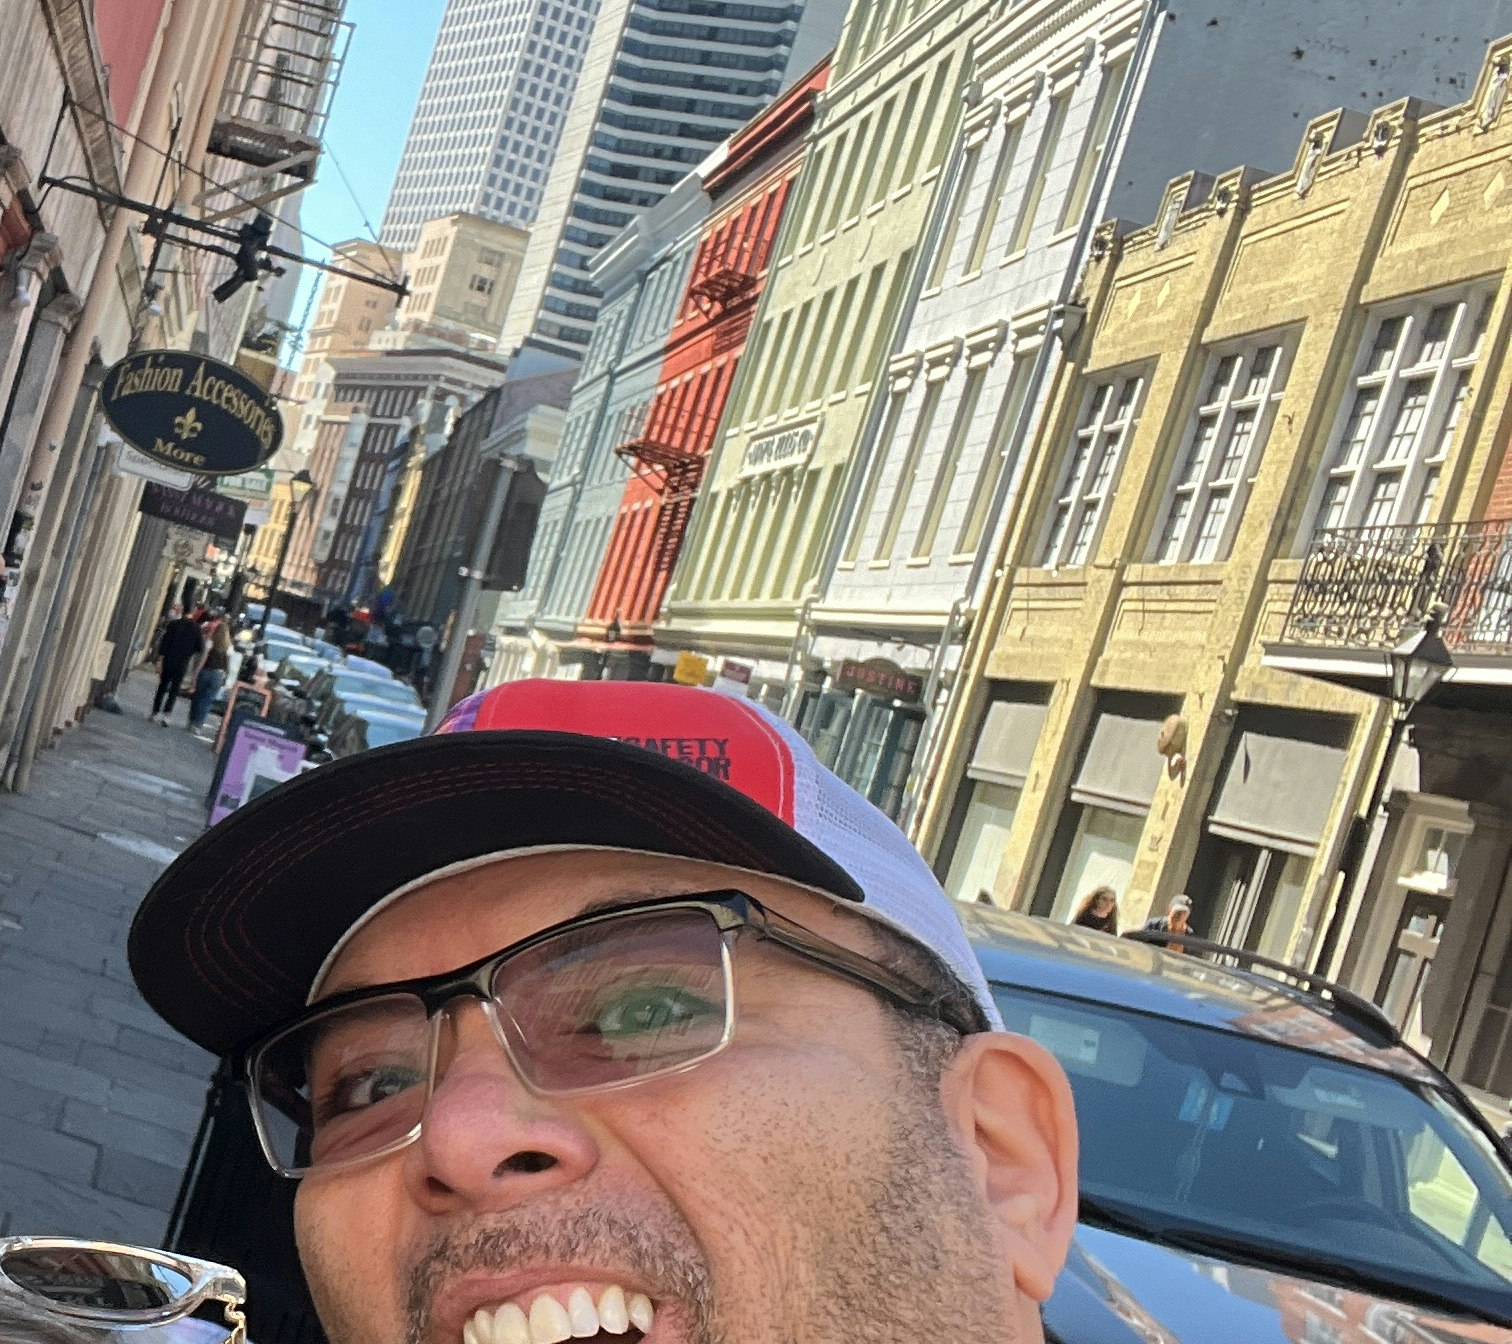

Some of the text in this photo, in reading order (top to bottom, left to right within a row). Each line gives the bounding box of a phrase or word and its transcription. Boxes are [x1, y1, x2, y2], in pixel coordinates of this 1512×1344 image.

[111, 355, 276, 449] Fashion Accessories
[152, 437, 206, 466] More
